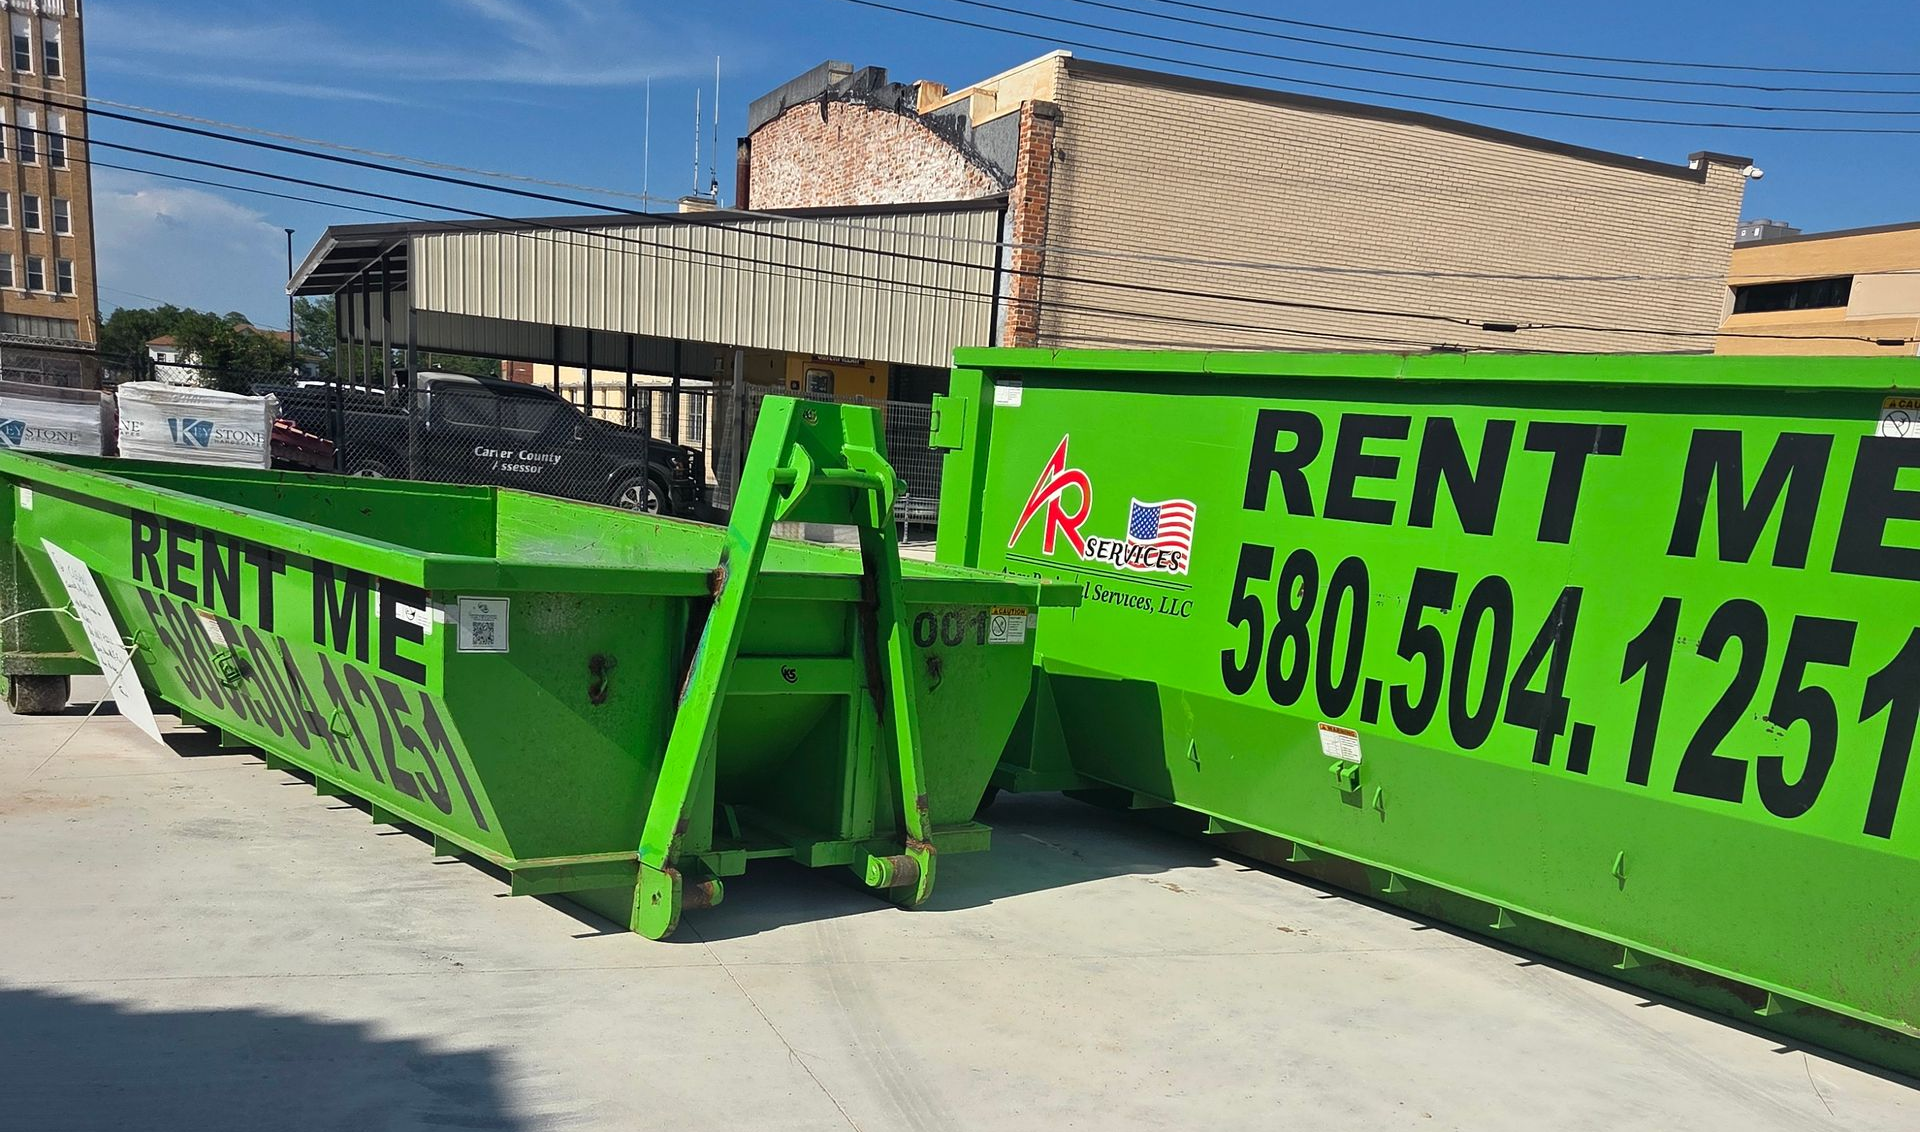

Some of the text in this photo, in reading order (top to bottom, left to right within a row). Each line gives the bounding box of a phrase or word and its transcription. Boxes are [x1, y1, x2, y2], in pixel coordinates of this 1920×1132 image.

[519, 449, 562, 466] County
[1243, 408, 1920, 581] RENT ME
[1085, 537, 1183, 572] SERVICES
[130, 510, 287, 633] RENT
[312, 560, 427, 687] ME
[999, 608, 1026, 617] CAUTION
[1091, 583, 1155, 614] Services,
[1158, 595, 1194, 618] LLC
[913, 611, 987, 648] 001
[1221, 542, 1920, 840] 580.504.1251
